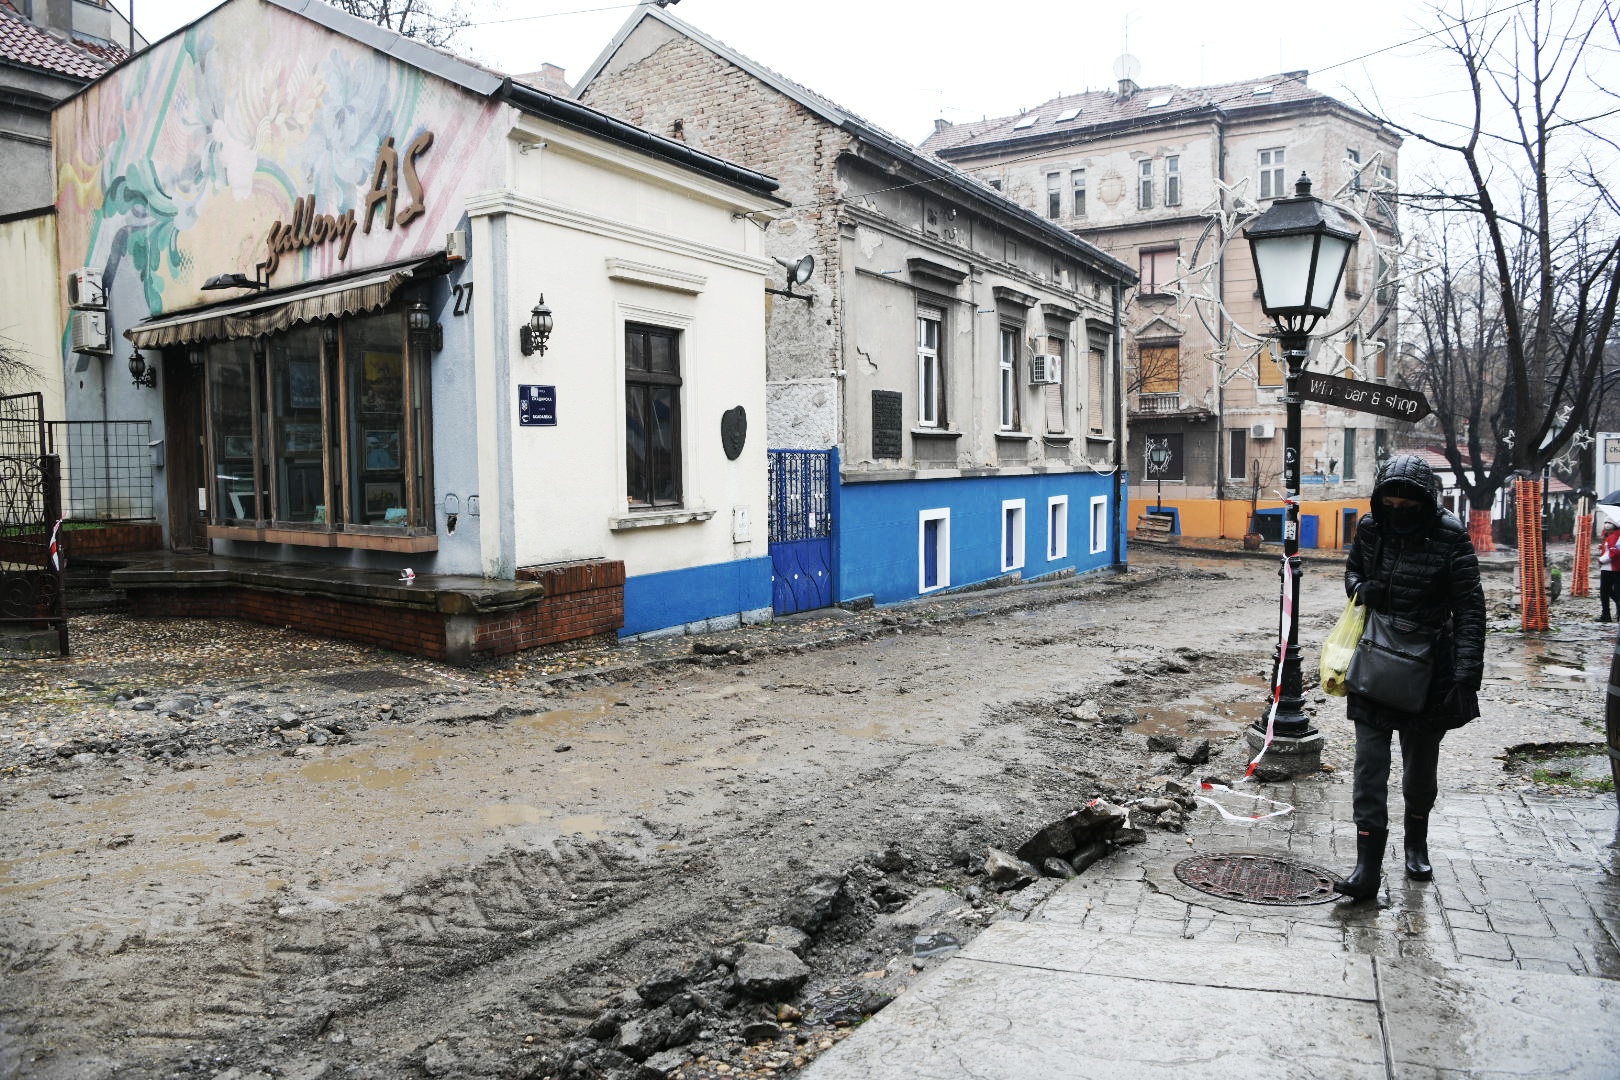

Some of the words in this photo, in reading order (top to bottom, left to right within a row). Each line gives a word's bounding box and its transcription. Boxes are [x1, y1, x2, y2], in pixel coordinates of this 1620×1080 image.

[265, 193, 358, 275] gallery
[362, 131, 435, 235] AS
[452, 281, 474, 317] 27
[1310, 379, 1341, 397] Win
[1371, 391, 1381, 405] &
[1385, 394, 1418, 415] shop
